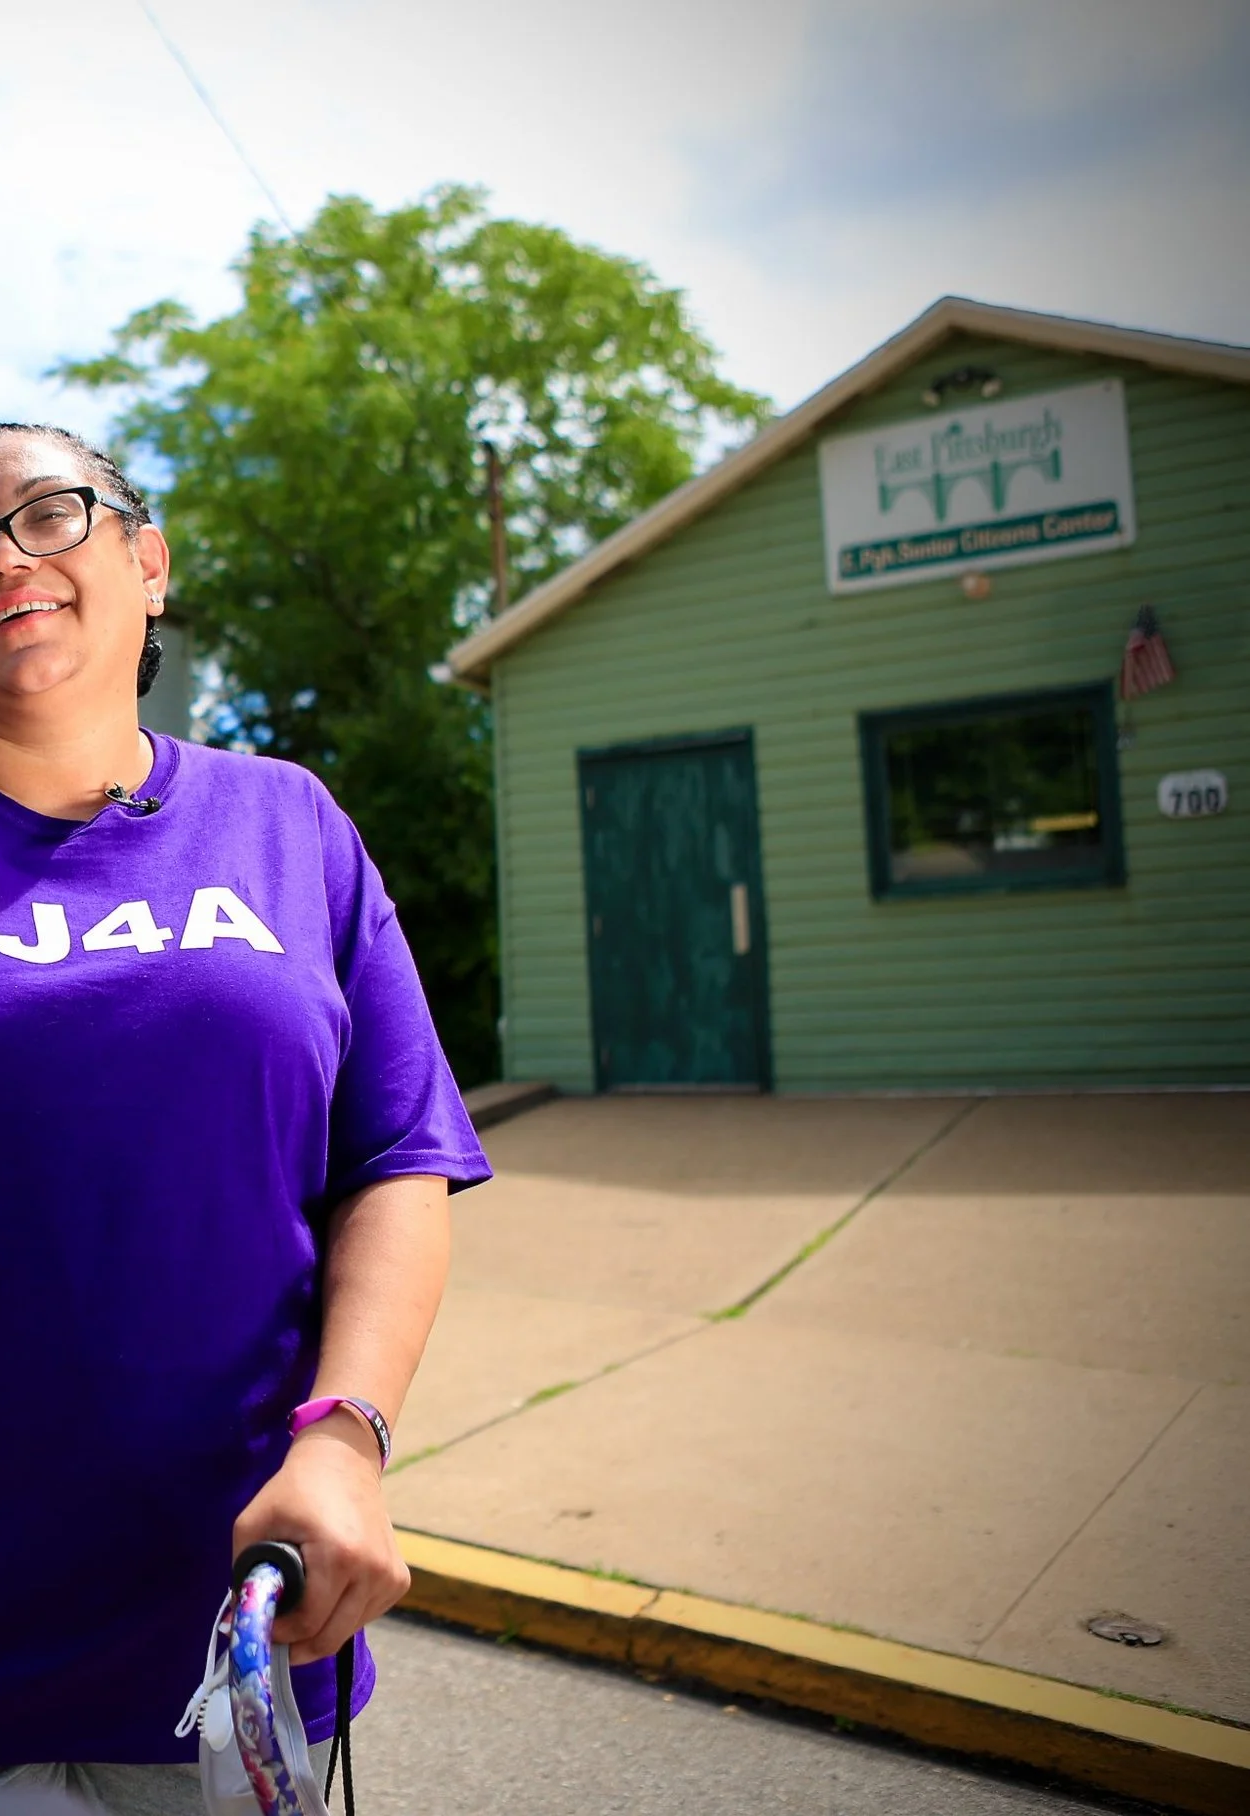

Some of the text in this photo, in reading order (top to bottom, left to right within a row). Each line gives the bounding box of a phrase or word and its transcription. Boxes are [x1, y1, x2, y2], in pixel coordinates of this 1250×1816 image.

[930, 407, 1062, 467] Pittsburgh
[897, 538, 958, 562] Senior
[960, 524, 1040, 553] Citizens
[1042, 510, 1116, 539] Center
[1170, 786, 1220, 816] 700
